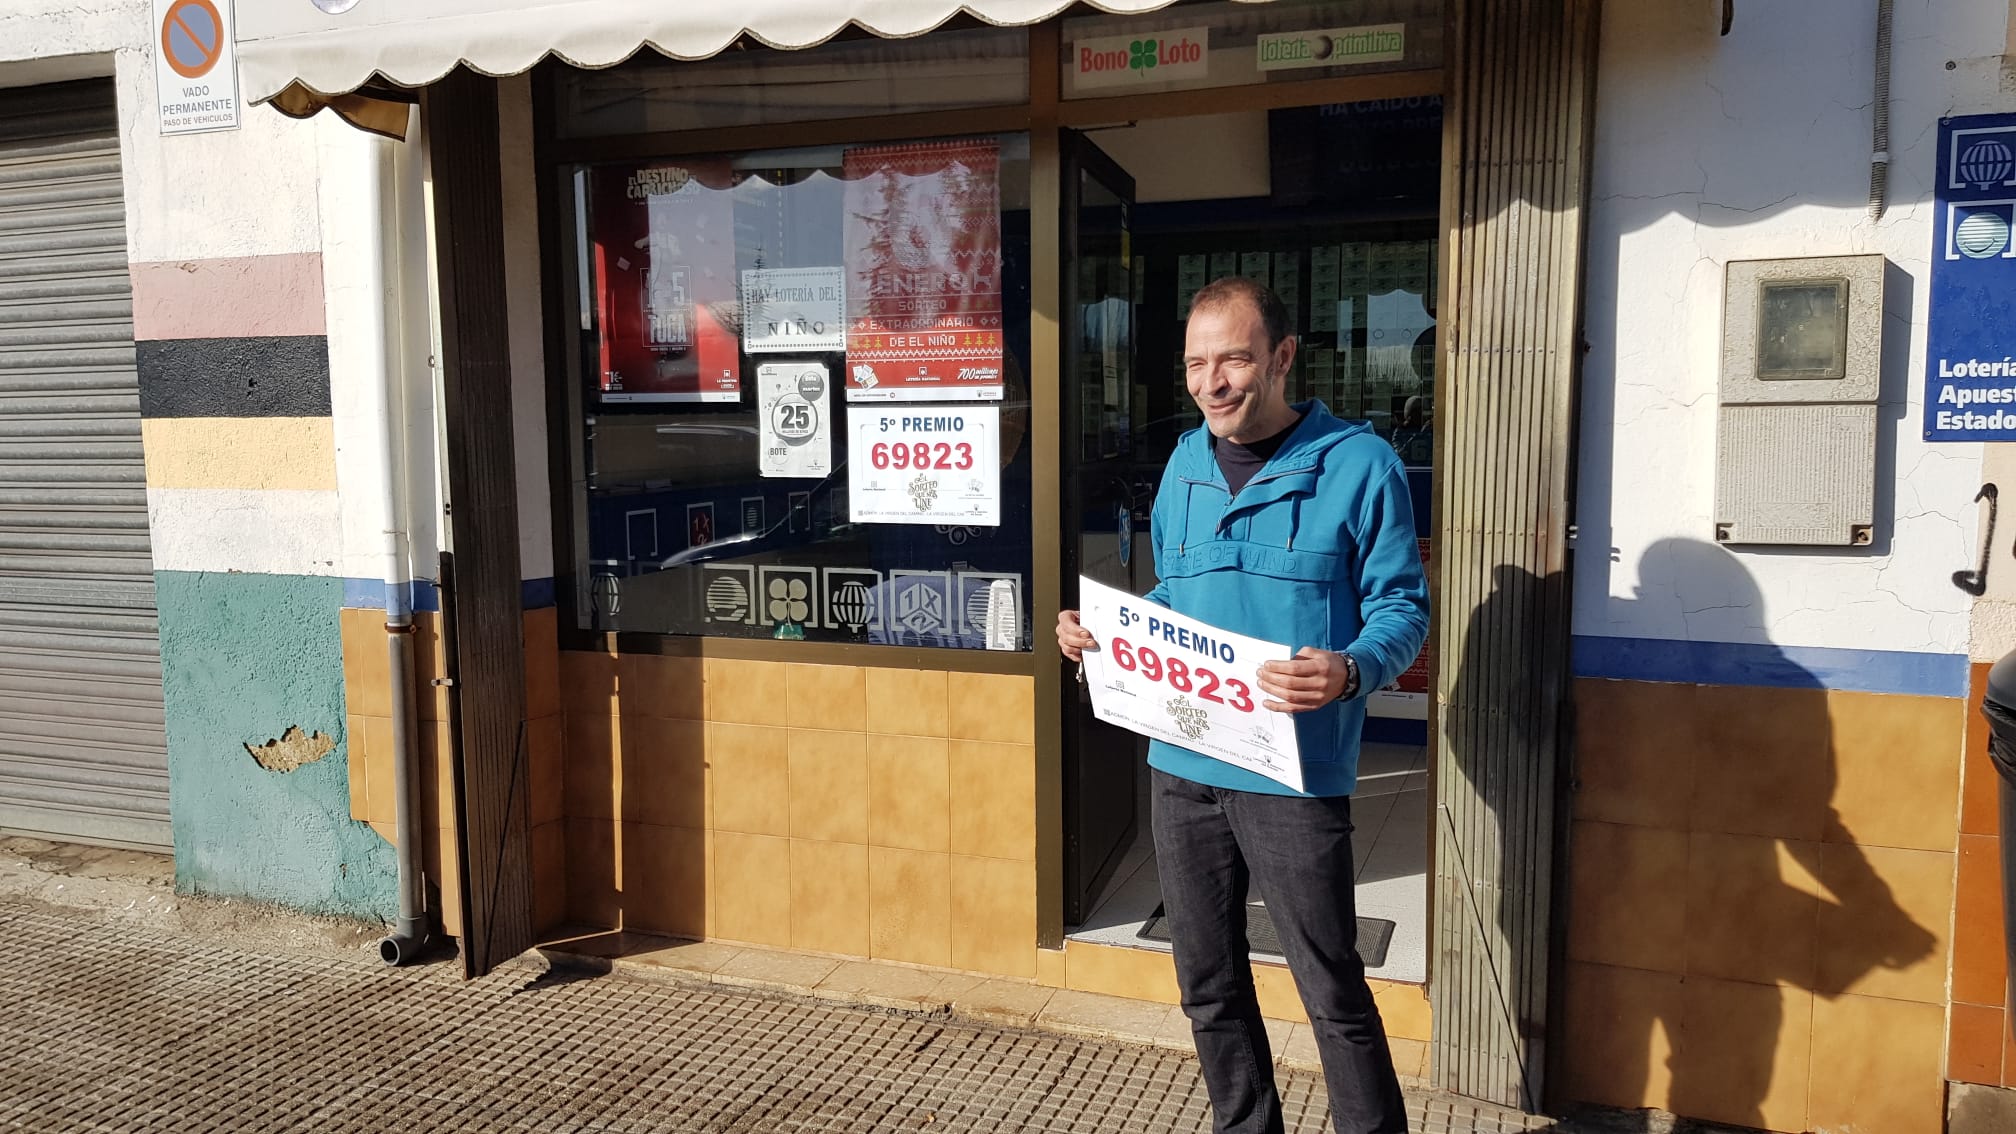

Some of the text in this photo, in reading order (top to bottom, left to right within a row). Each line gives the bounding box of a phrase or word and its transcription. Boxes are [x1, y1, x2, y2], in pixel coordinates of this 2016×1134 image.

[1080, 39, 1201, 73] Bono Loto
[183, 85, 210, 98] VADO
[163, 98, 233, 116] PERMANENTE
[164, 113, 233, 127] PASO DE VEHICULOS
[637, 167, 689, 184] DESTINO
[751, 284, 837, 304] HAY LOTERÍA DEL
[898, 300, 947, 311] SORTEO
[767, 318, 825, 337] NIÑO
[870, 317, 974, 330] EXTRAORDINARIO
[889, 334, 956, 347] DE EL NIÑO
[957, 367, 975, 380] 700
[780, 405, 810, 430] 25
[902, 416, 965, 432] PREMIO
[1936, 409, 2016, 430] Estado
[769, 447, 787, 456] BOTE
[871, 442, 974, 470] 69823
[907, 481, 938, 496] SORTEO
[1209, 543, 1237, 563] OF
[1243, 548, 1297, 574] MIND
[1148, 616, 1235, 664] PREMIO
[1111, 637, 1255, 713] 69823
[1166, 700, 1208, 717] SORTEO
[1177, 714, 1193, 725] QUE
